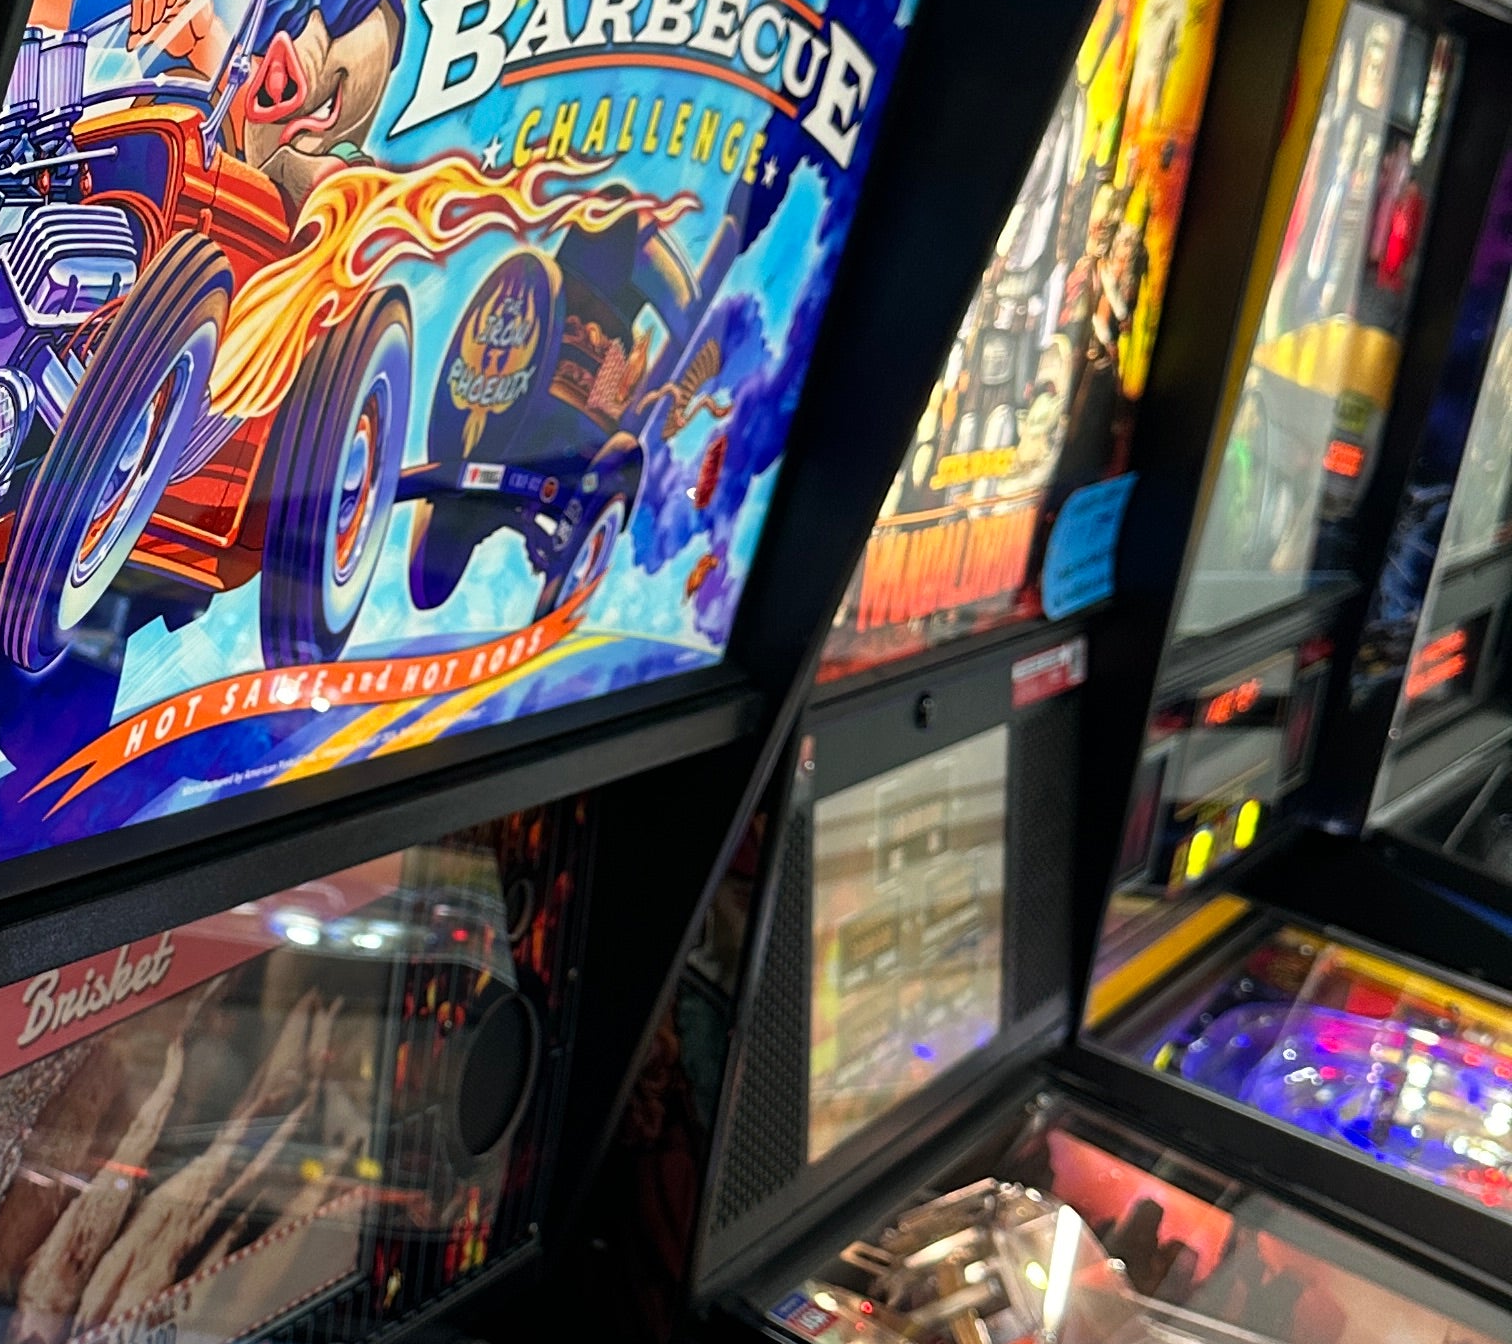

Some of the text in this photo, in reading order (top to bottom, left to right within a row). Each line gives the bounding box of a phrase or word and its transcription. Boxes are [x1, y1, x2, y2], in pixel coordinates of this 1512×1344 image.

[513, 97, 770, 184] CHALLENGE
[448, 359, 536, 405] PHOENIX
[123, 625, 545, 758] HOT SAUCE and HOT RODS
[16, 930, 177, 1048] Brisket
